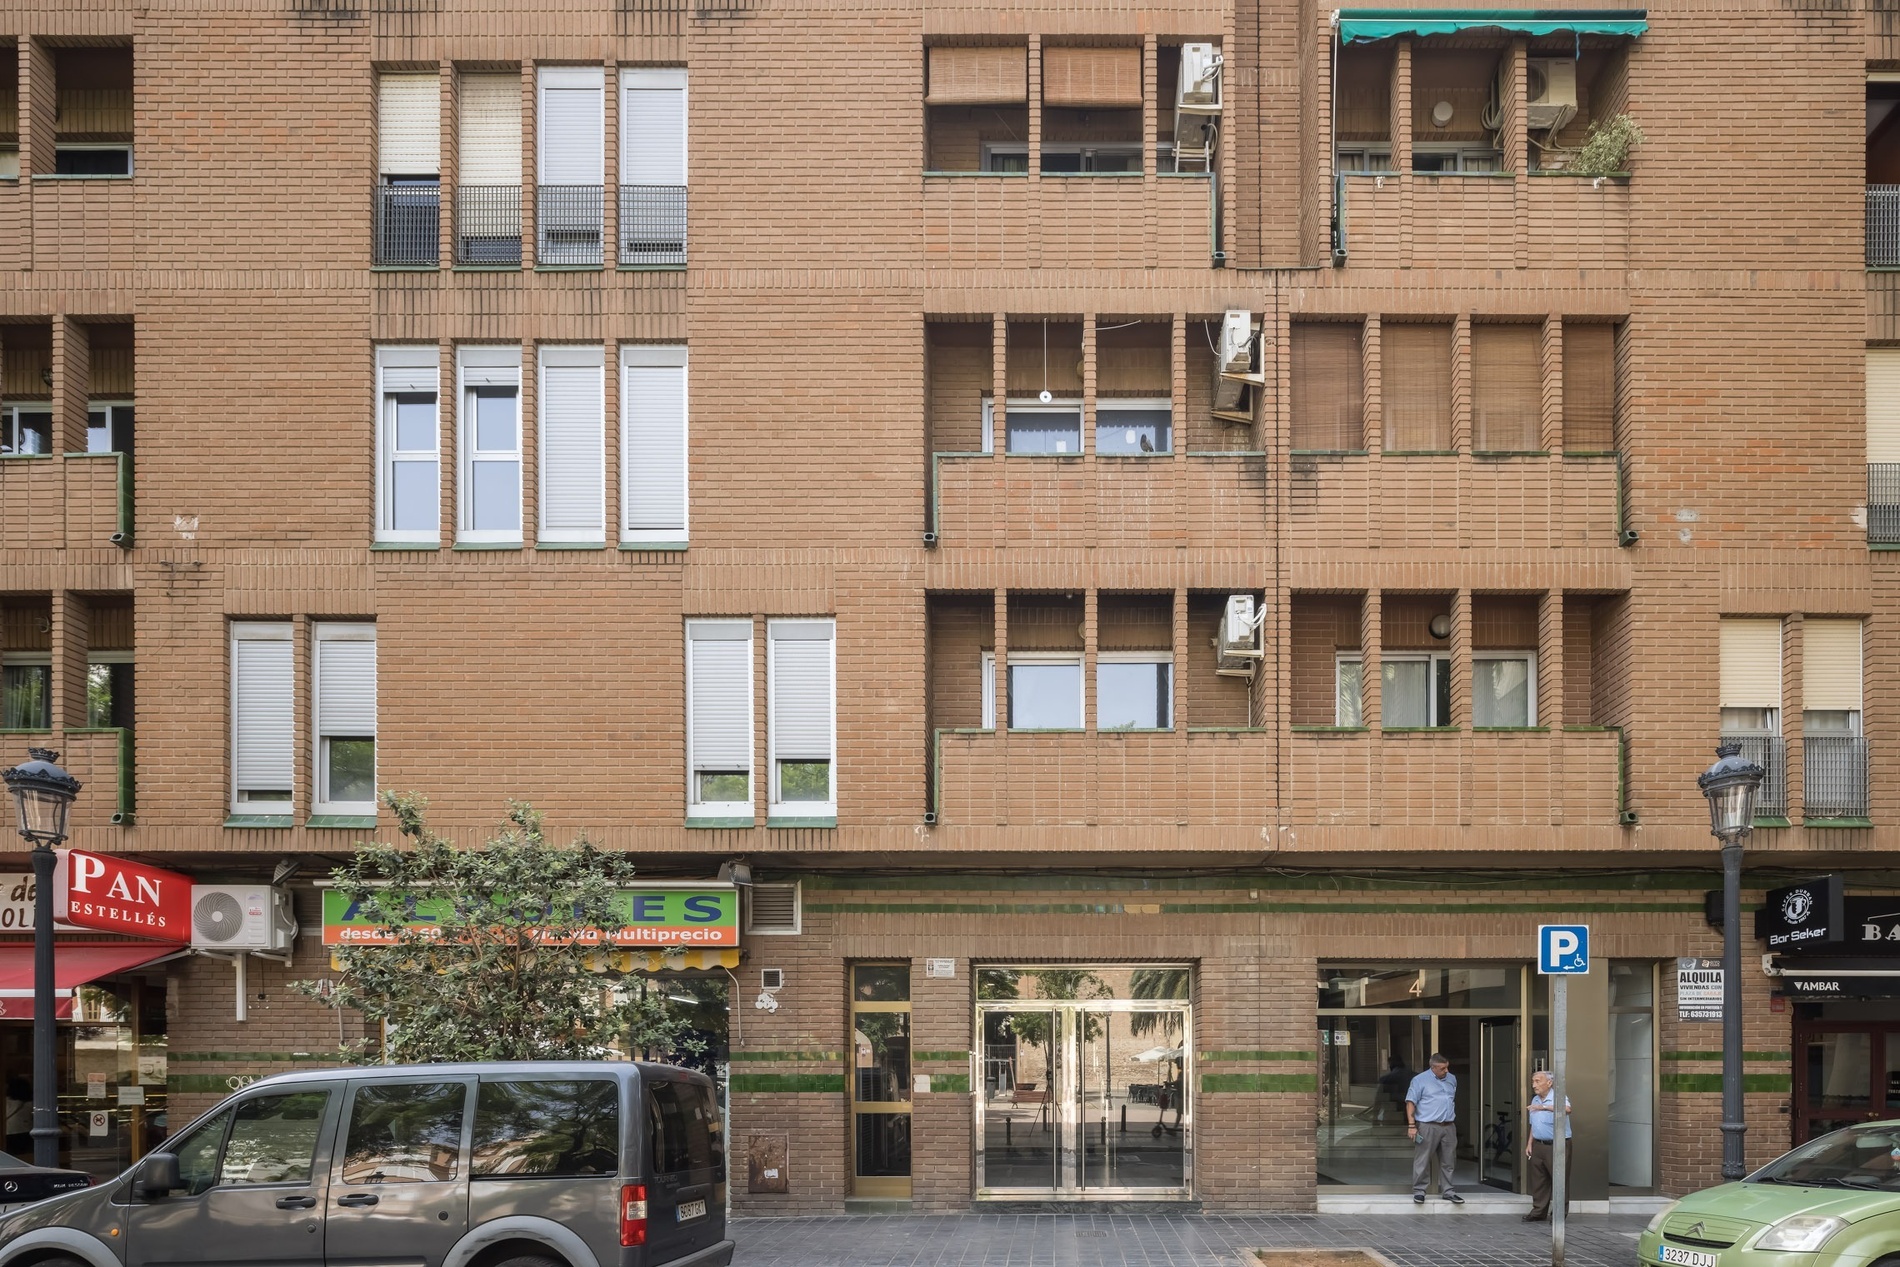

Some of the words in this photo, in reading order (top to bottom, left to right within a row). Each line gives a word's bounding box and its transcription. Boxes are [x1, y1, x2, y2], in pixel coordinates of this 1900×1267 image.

[70, 852, 162, 907] PAN
[70, 900, 166, 928] ESTELLÉS
[1770, 934, 1789, 945] Bar
[1791, 928, 1827, 941] Seker
[1550, 930, 1579, 967] P
[1680, 972, 1722, 984] ALQUILA
[1802, 981, 1840, 991] AMBAR
[1408, 979, 1422, 997] 4
[1665, 1248, 1690, 1264] 3237
[1692, 1253, 1714, 1267] DJJ
